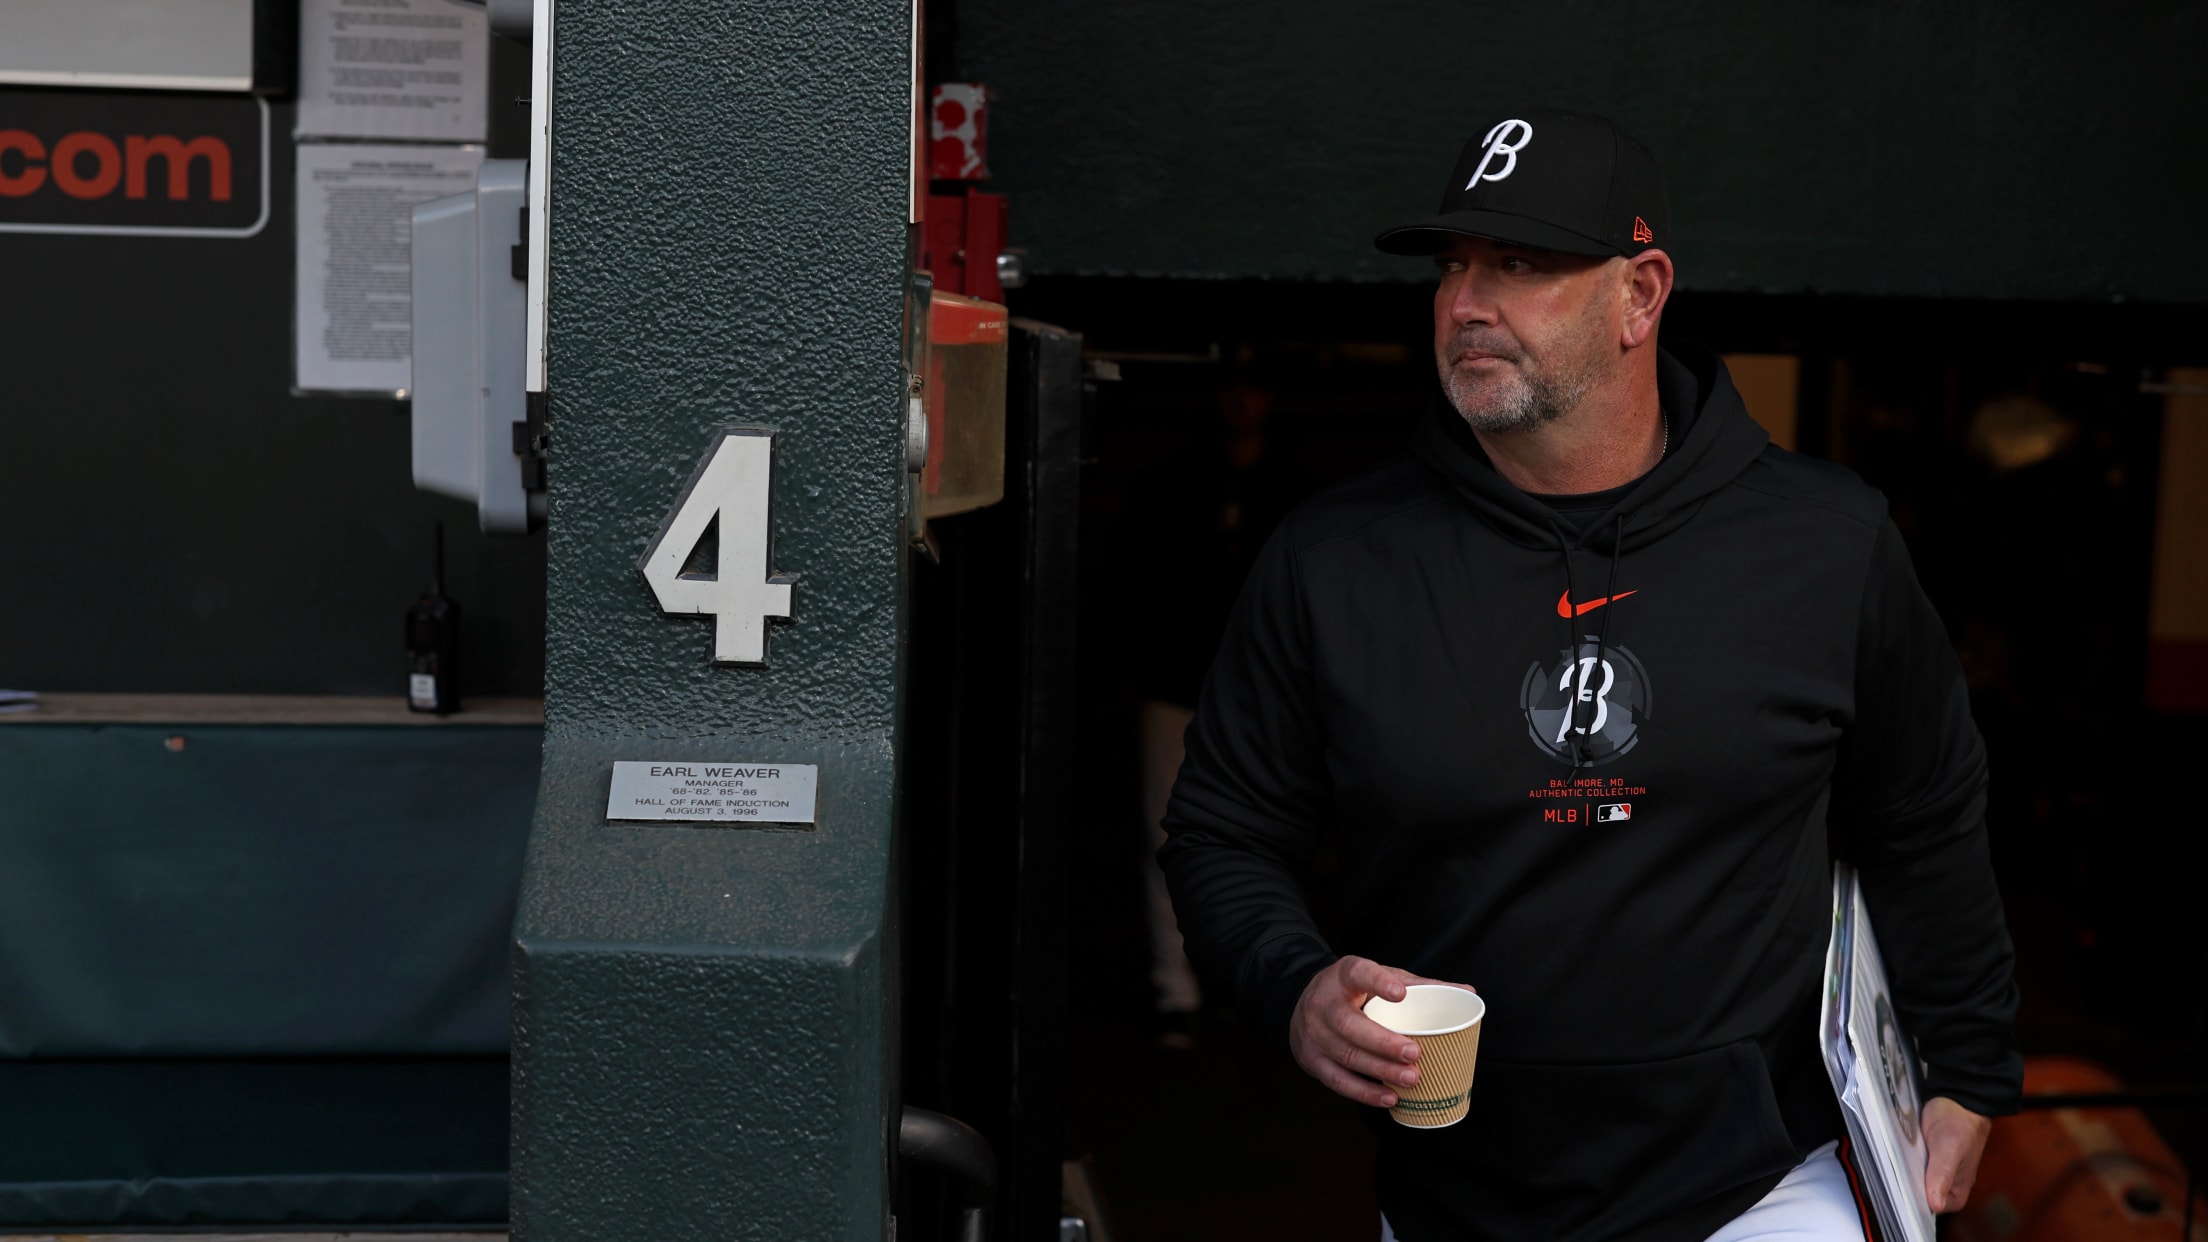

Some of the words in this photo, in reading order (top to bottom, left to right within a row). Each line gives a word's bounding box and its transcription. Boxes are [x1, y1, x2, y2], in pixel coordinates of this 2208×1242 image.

[1465, 118, 1533, 191] B
[0, 129, 231, 201] com
[636, 428, 799, 669] 4
[1556, 656, 1615, 743] B
[650, 766, 698, 777] EARL
[705, 767, 780, 779] WEAVER
[1550, 779, 1606, 788] BALIMORE,
[1610, 778, 1624, 787] MD
[1529, 788, 1583, 798] AUTHENTIC
[1586, 787, 1646, 797] COLLECTION
[635, 798, 666, 806] HALL
[690, 799, 722, 807] FAME
[726, 800, 790, 808] INDUCTION
[665, 807, 712, 815] AUGUST
[733, 808, 758, 816] 1996
[1544, 809, 1577, 823] MLB
